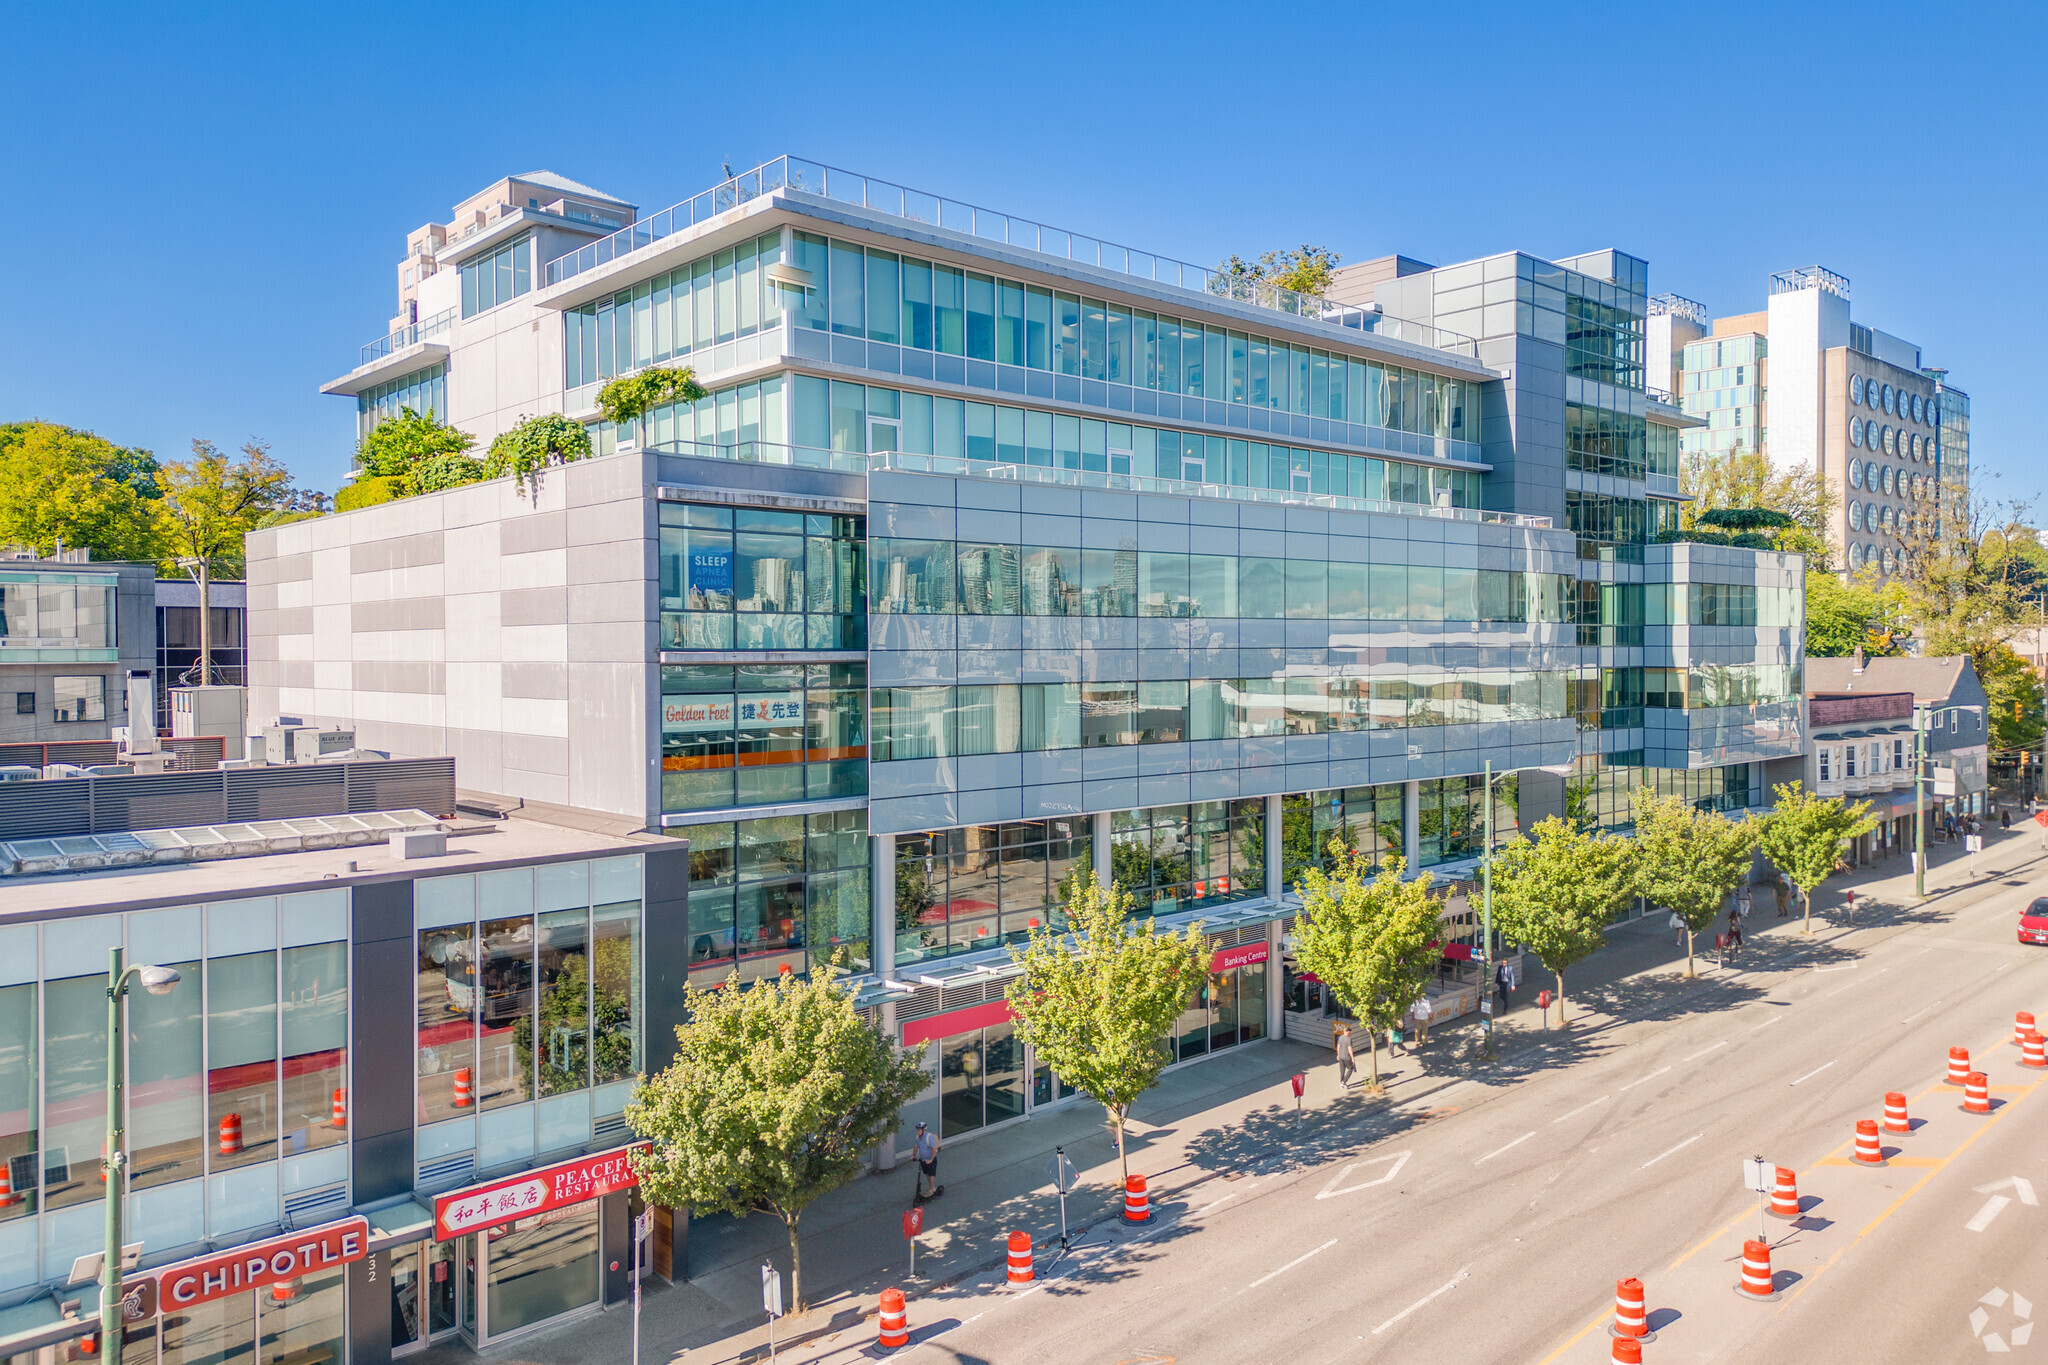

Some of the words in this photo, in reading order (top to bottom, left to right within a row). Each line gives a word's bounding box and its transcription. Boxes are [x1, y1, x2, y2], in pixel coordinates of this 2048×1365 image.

[694, 555, 728, 567] SLEEP
[695, 567, 728, 577] APNEA
[695, 577, 728, 586] CLINIC
[665, 704, 705, 723] Golden
[707, 703, 730, 721] Feet
[1224, 955, 1248, 967] Banking
[1247, 951, 1267, 961] Centre
[554, 1156, 637, 1190] PEACEFU
[453, 1185, 539, 1223] 和平飯店
[172, 1230, 361, 1303] CHIPOTLE
